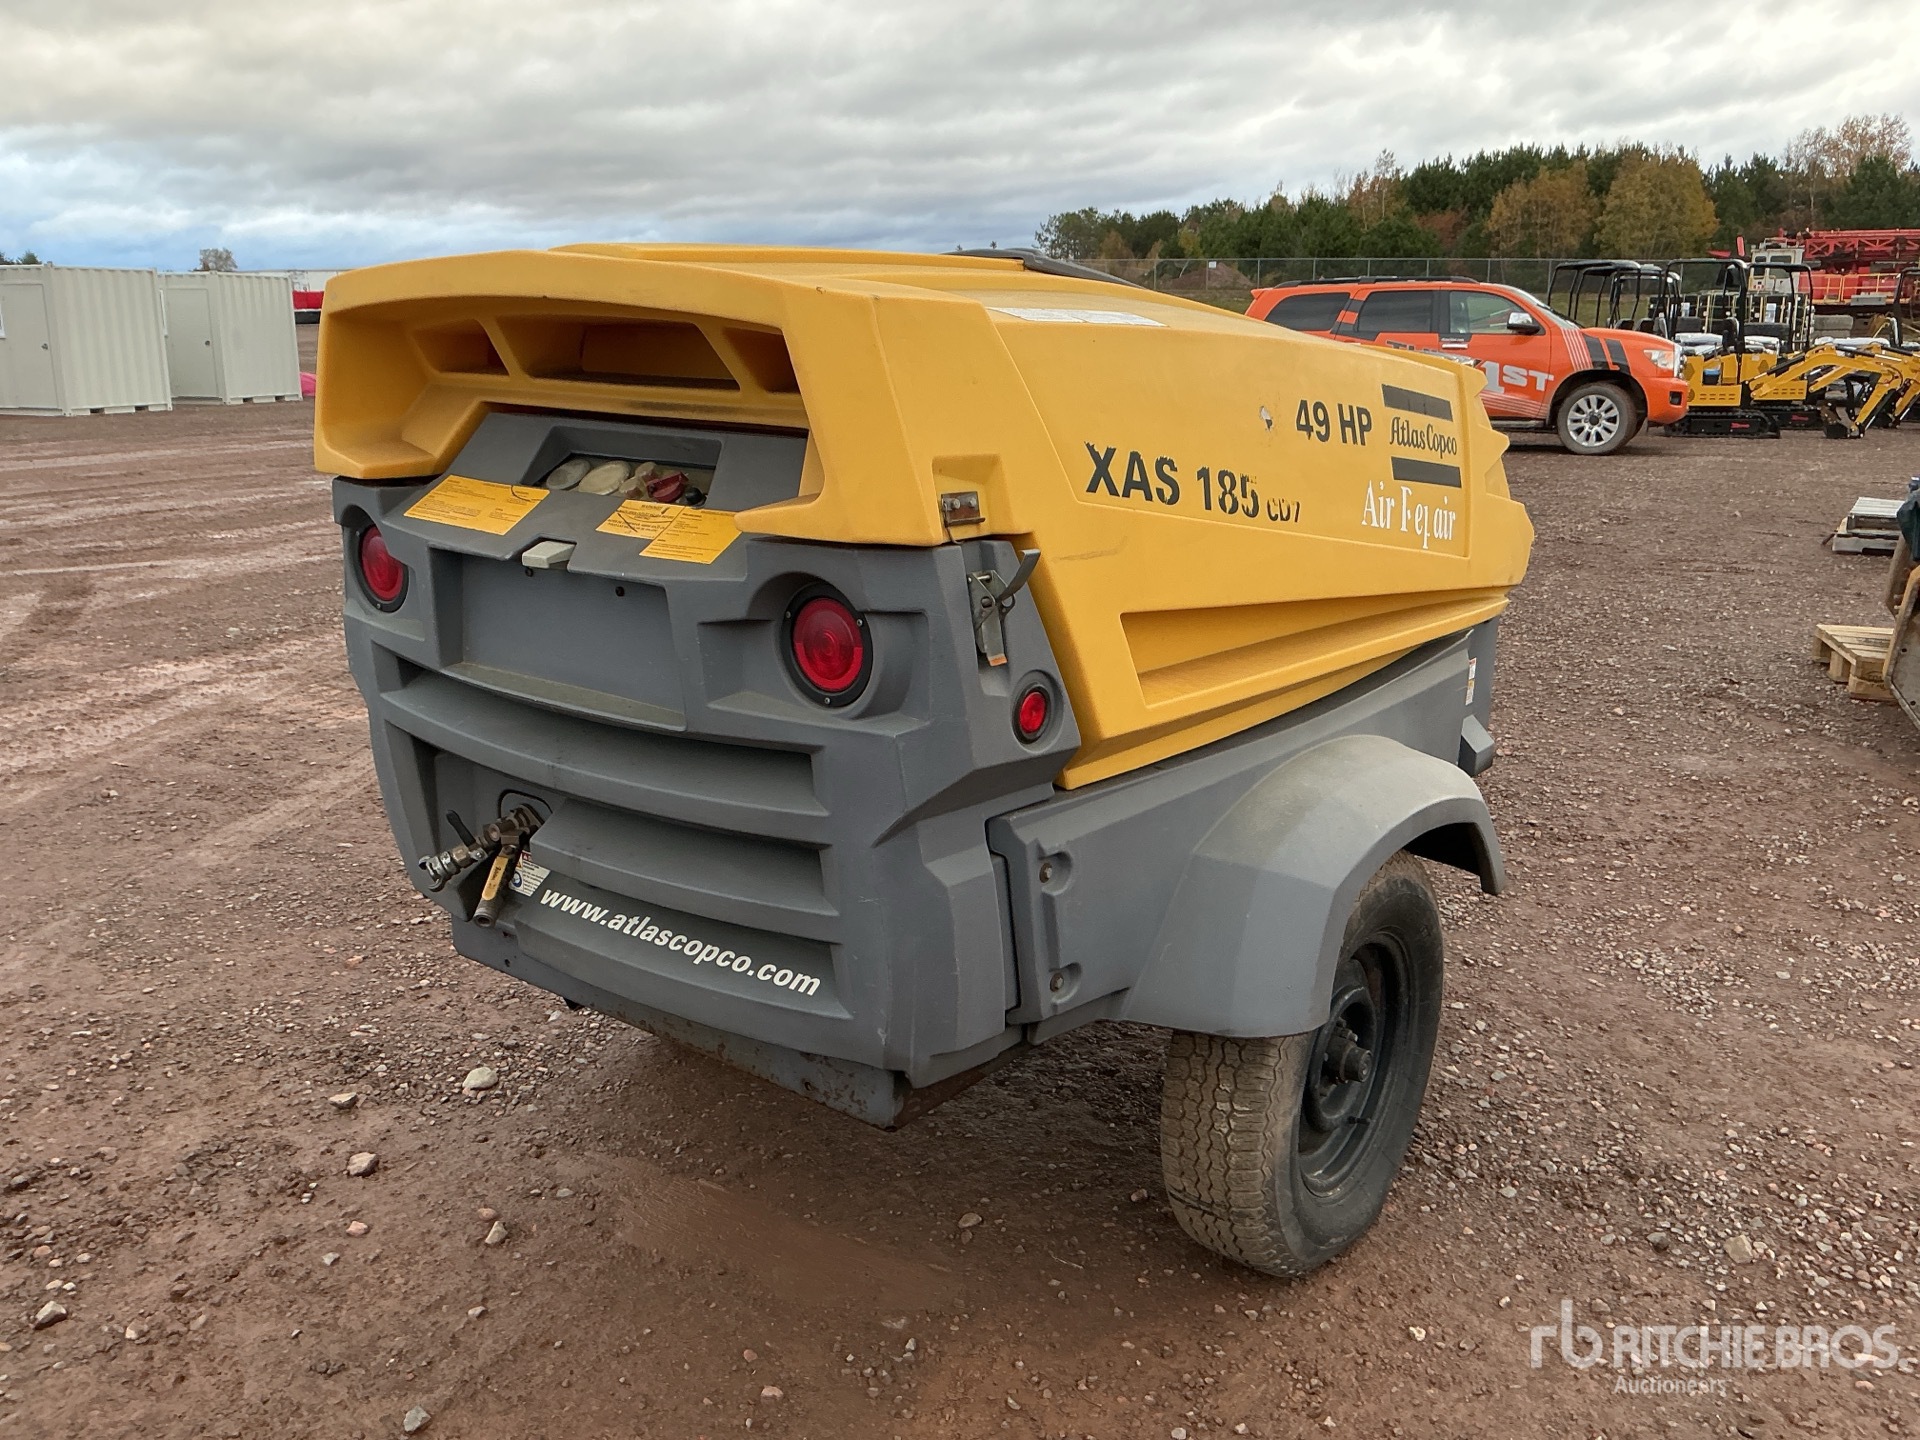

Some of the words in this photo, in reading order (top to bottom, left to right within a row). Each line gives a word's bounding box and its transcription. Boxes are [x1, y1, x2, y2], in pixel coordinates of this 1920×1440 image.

[1479, 360, 1554, 394] 1ST
[1296, 399, 1331, 442] 49
[1337, 403, 1372, 446] HP
[1084, 441, 1180, 505] XAS
[1196, 466, 1260, 518] 185
[1361, 479, 1395, 530] Air
[540, 888, 821, 996] www.atlascopco.com
